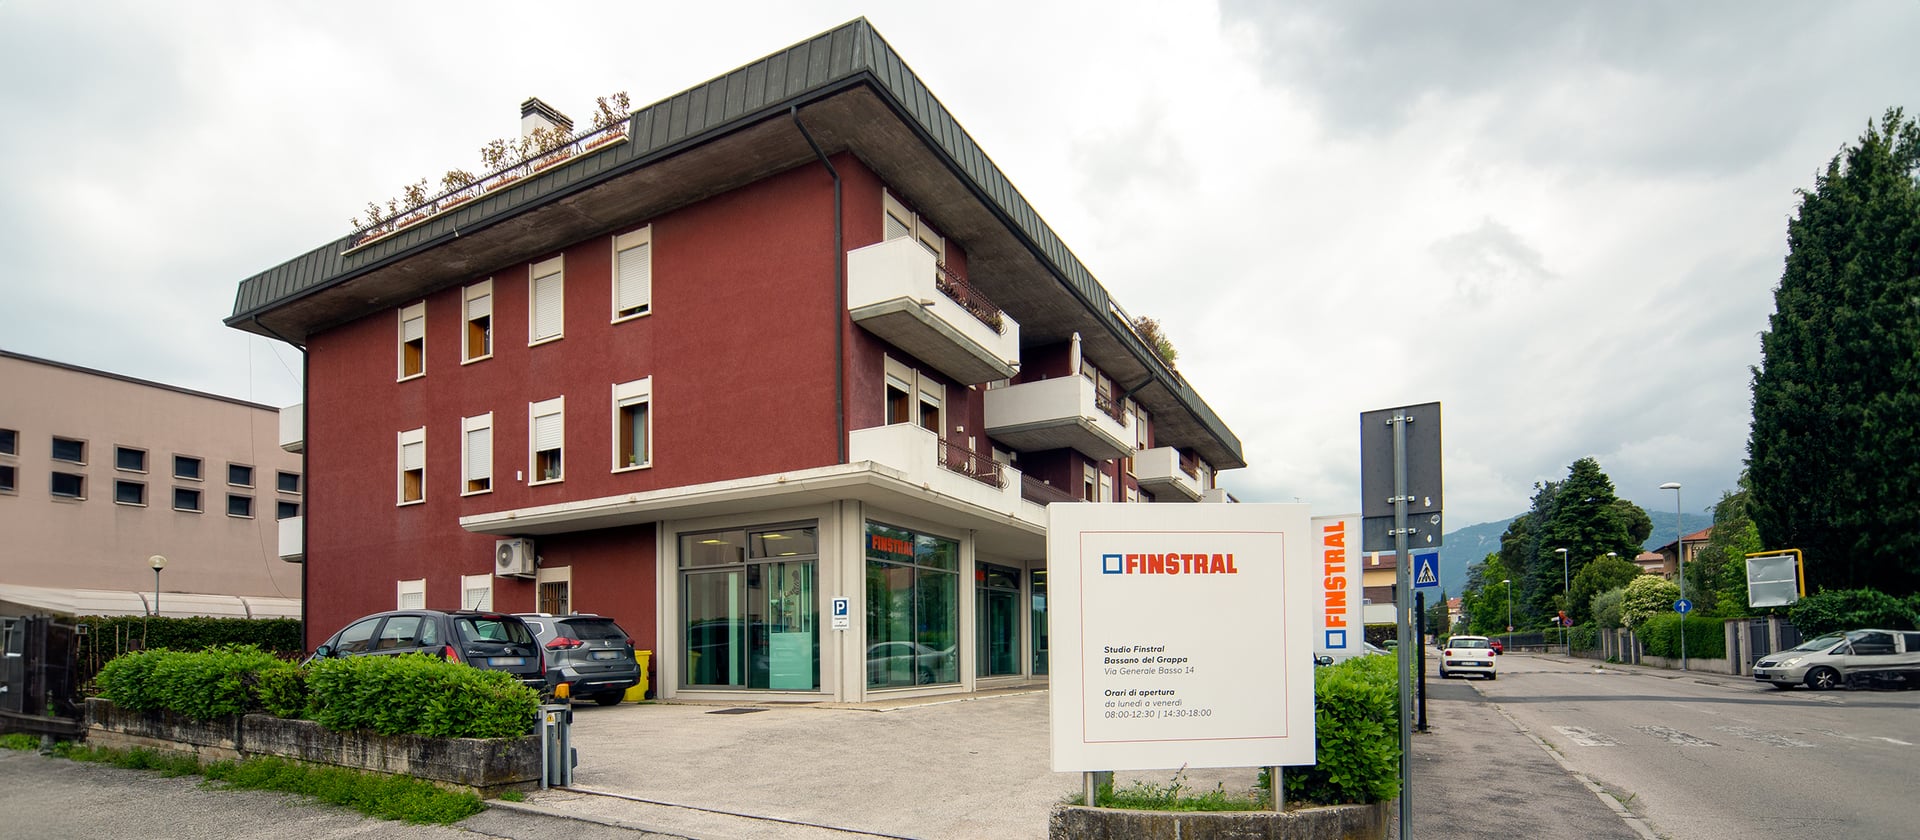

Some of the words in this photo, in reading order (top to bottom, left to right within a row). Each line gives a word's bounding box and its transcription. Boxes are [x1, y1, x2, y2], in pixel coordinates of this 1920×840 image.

[1125, 553, 1238, 575] FINSTRAL
[1323, 520, 1347, 628] FINSTRAL
[836, 601, 845, 614] P
[1103, 645, 1132, 654] Studio
[1133, 645, 1165, 653] Finstral
[1103, 656, 1140, 664] Bassano
[1141, 656, 1155, 664] del
[1156, 655, 1188, 665] Grappa
[1104, 667, 1118, 675] Via
[1119, 667, 1156, 675] Generale
[1158, 666, 1183, 675] Basso
[1184, 666, 1195, 674] 14
[1104, 689, 1127, 697] Orari
[1128, 688, 1137, 697] di
[1138, 688, 1175, 698] apertura
[1104, 700, 1116, 708] da
[1104, 710, 1155, 719] 08:00-12:30
[1163, 708, 1212, 718] 14:30-18:00
